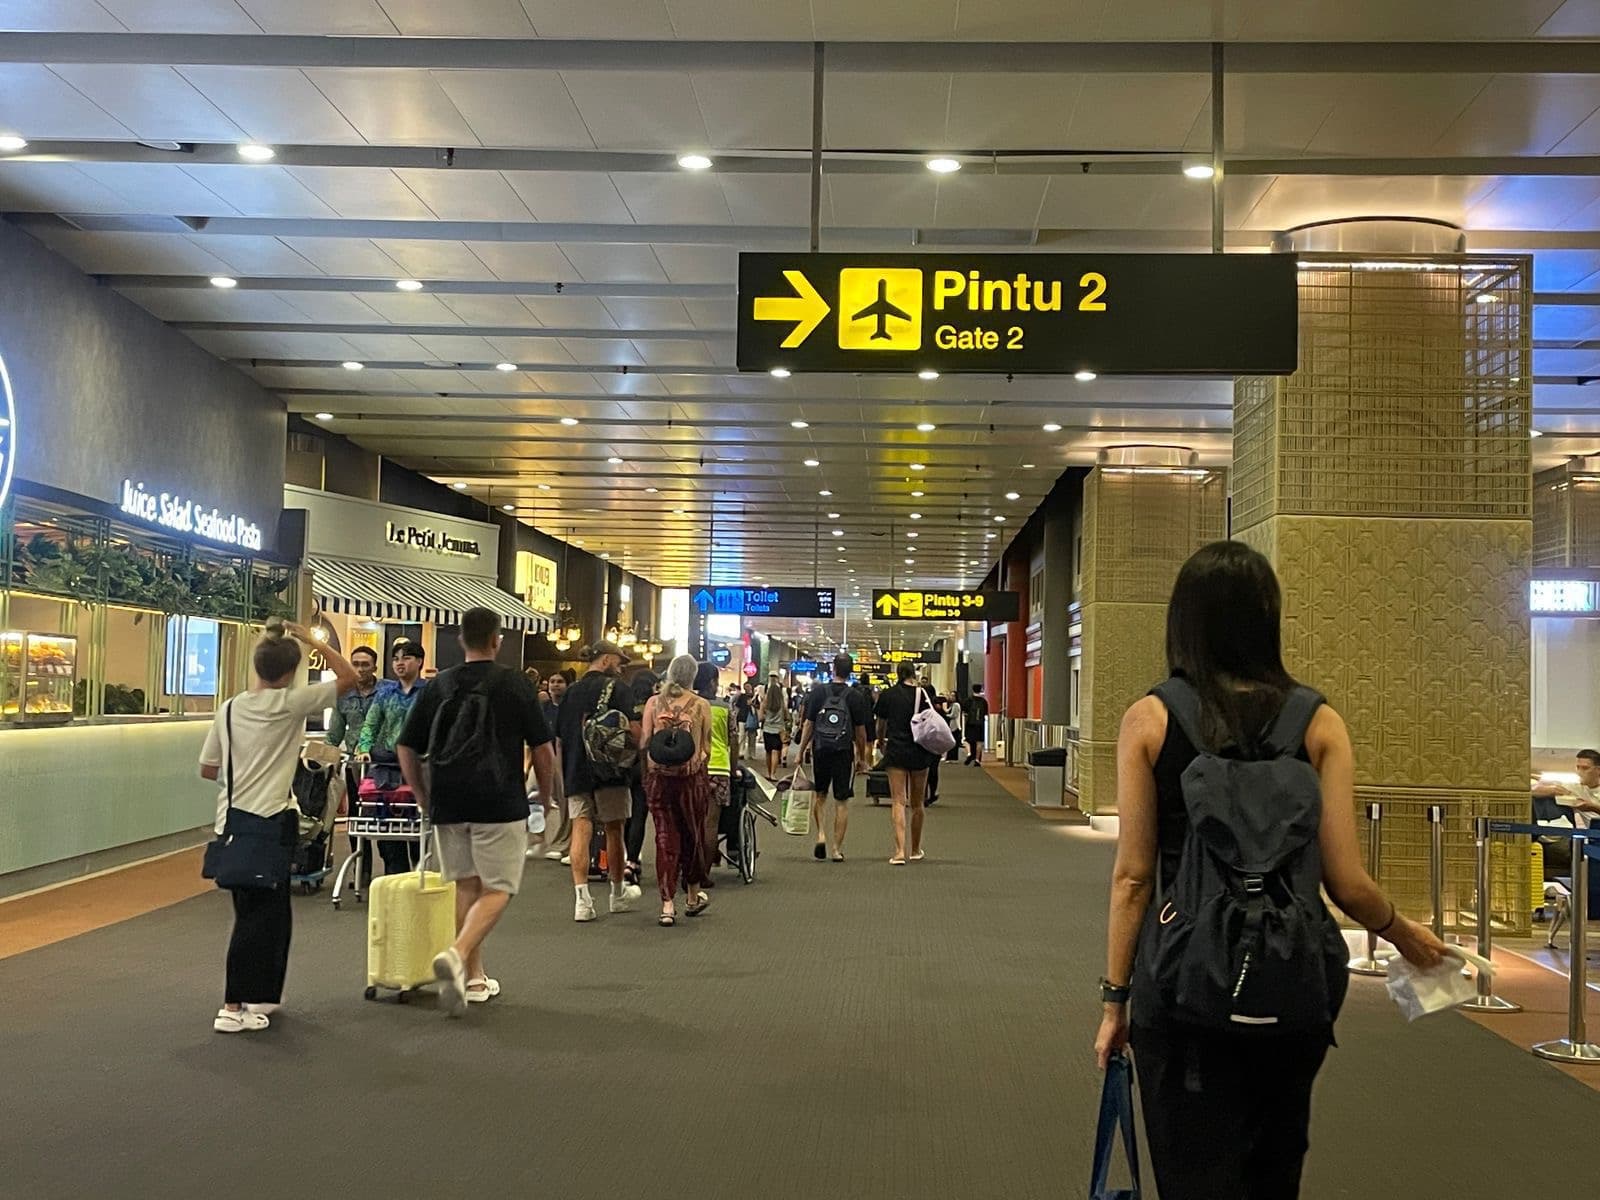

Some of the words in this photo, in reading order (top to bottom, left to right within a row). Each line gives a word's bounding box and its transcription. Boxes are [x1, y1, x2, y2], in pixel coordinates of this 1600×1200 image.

[933, 270, 1062, 311] Pintu
[1078, 272, 1107, 311] 2
[935, 325, 999, 350] Gate
[1006, 326, 1024, 350] 2
[194, 505, 237, 543] Seafood
[237, 517, 261, 551] Pasta
[388, 522, 405, 544] Le
[407, 526, 435, 549] Petit
[744, 590, 779, 603] Toilet
[924, 594, 960, 607] Pintu
[962, 595, 984, 607] 3-9
[744, 603, 770, 612] Toilets
[947, 609, 961, 617] 3-9
